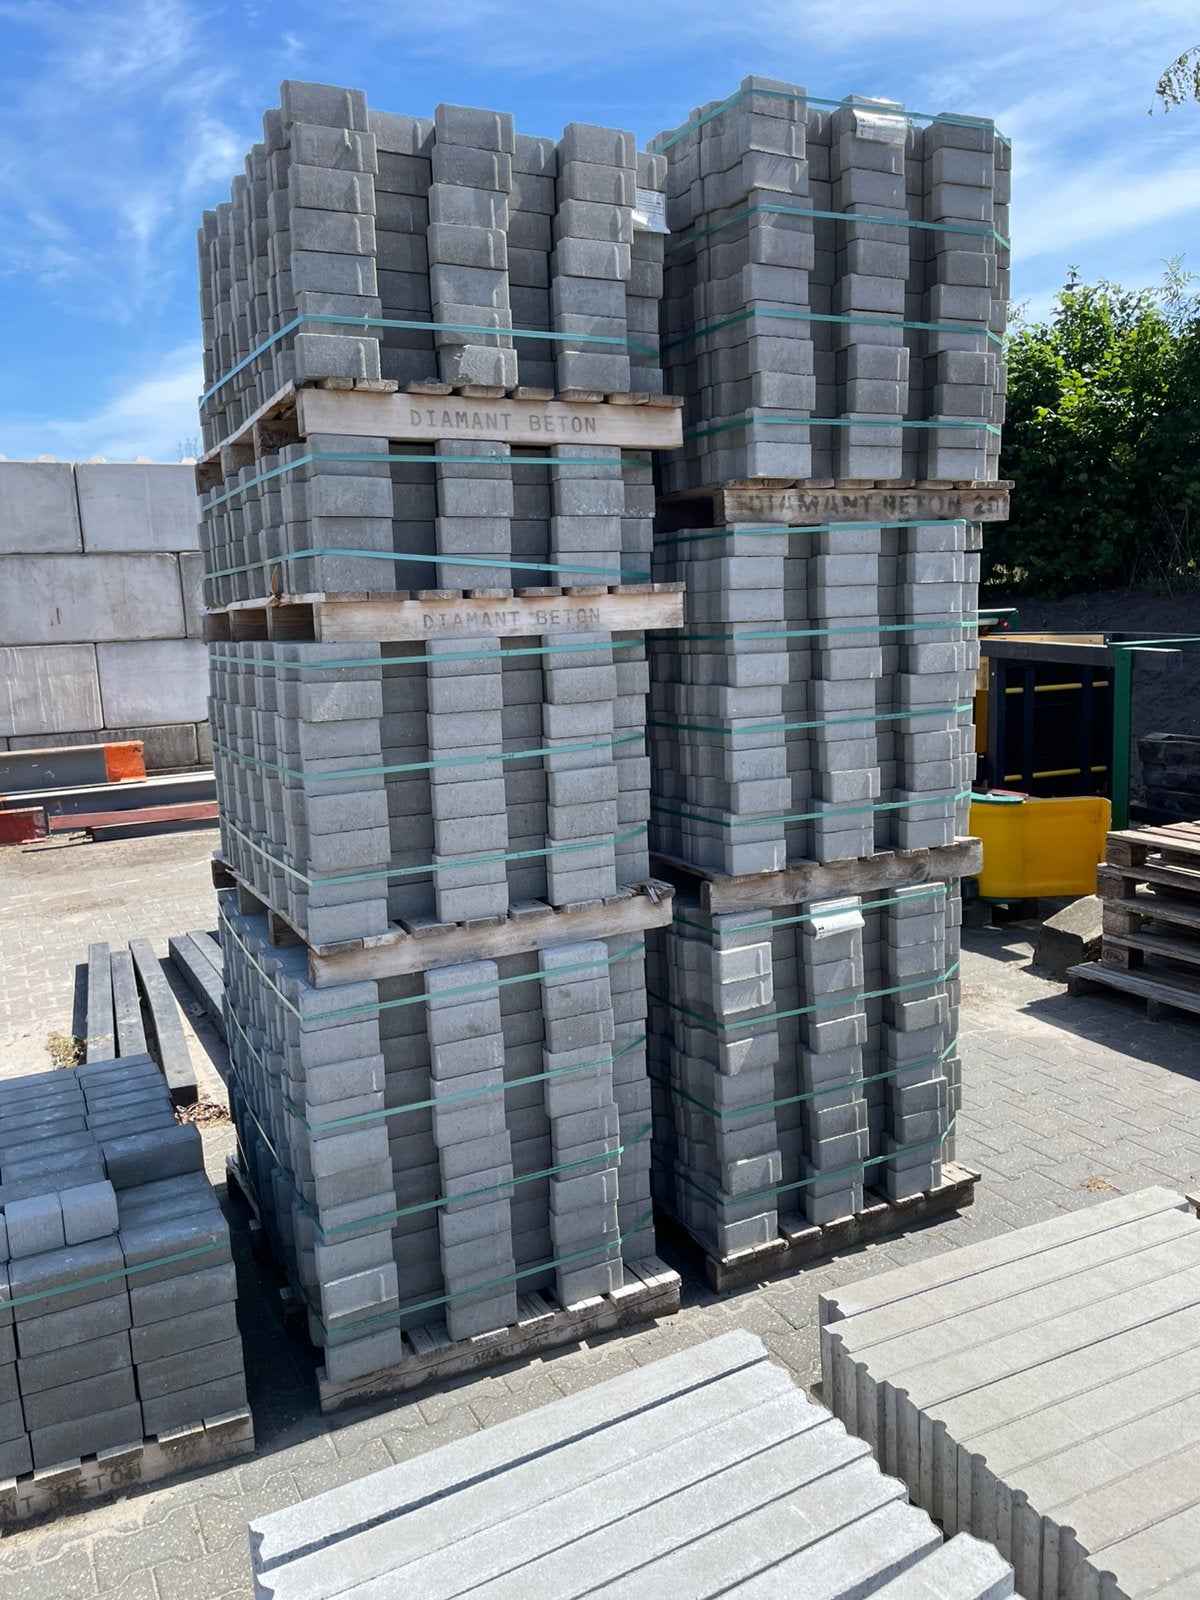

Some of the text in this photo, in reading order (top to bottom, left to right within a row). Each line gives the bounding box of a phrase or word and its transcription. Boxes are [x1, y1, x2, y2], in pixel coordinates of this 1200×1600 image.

[410, 408, 596, 433] DIAMANT BETON
[422, 608, 601, 629] DIAMANT BETON
